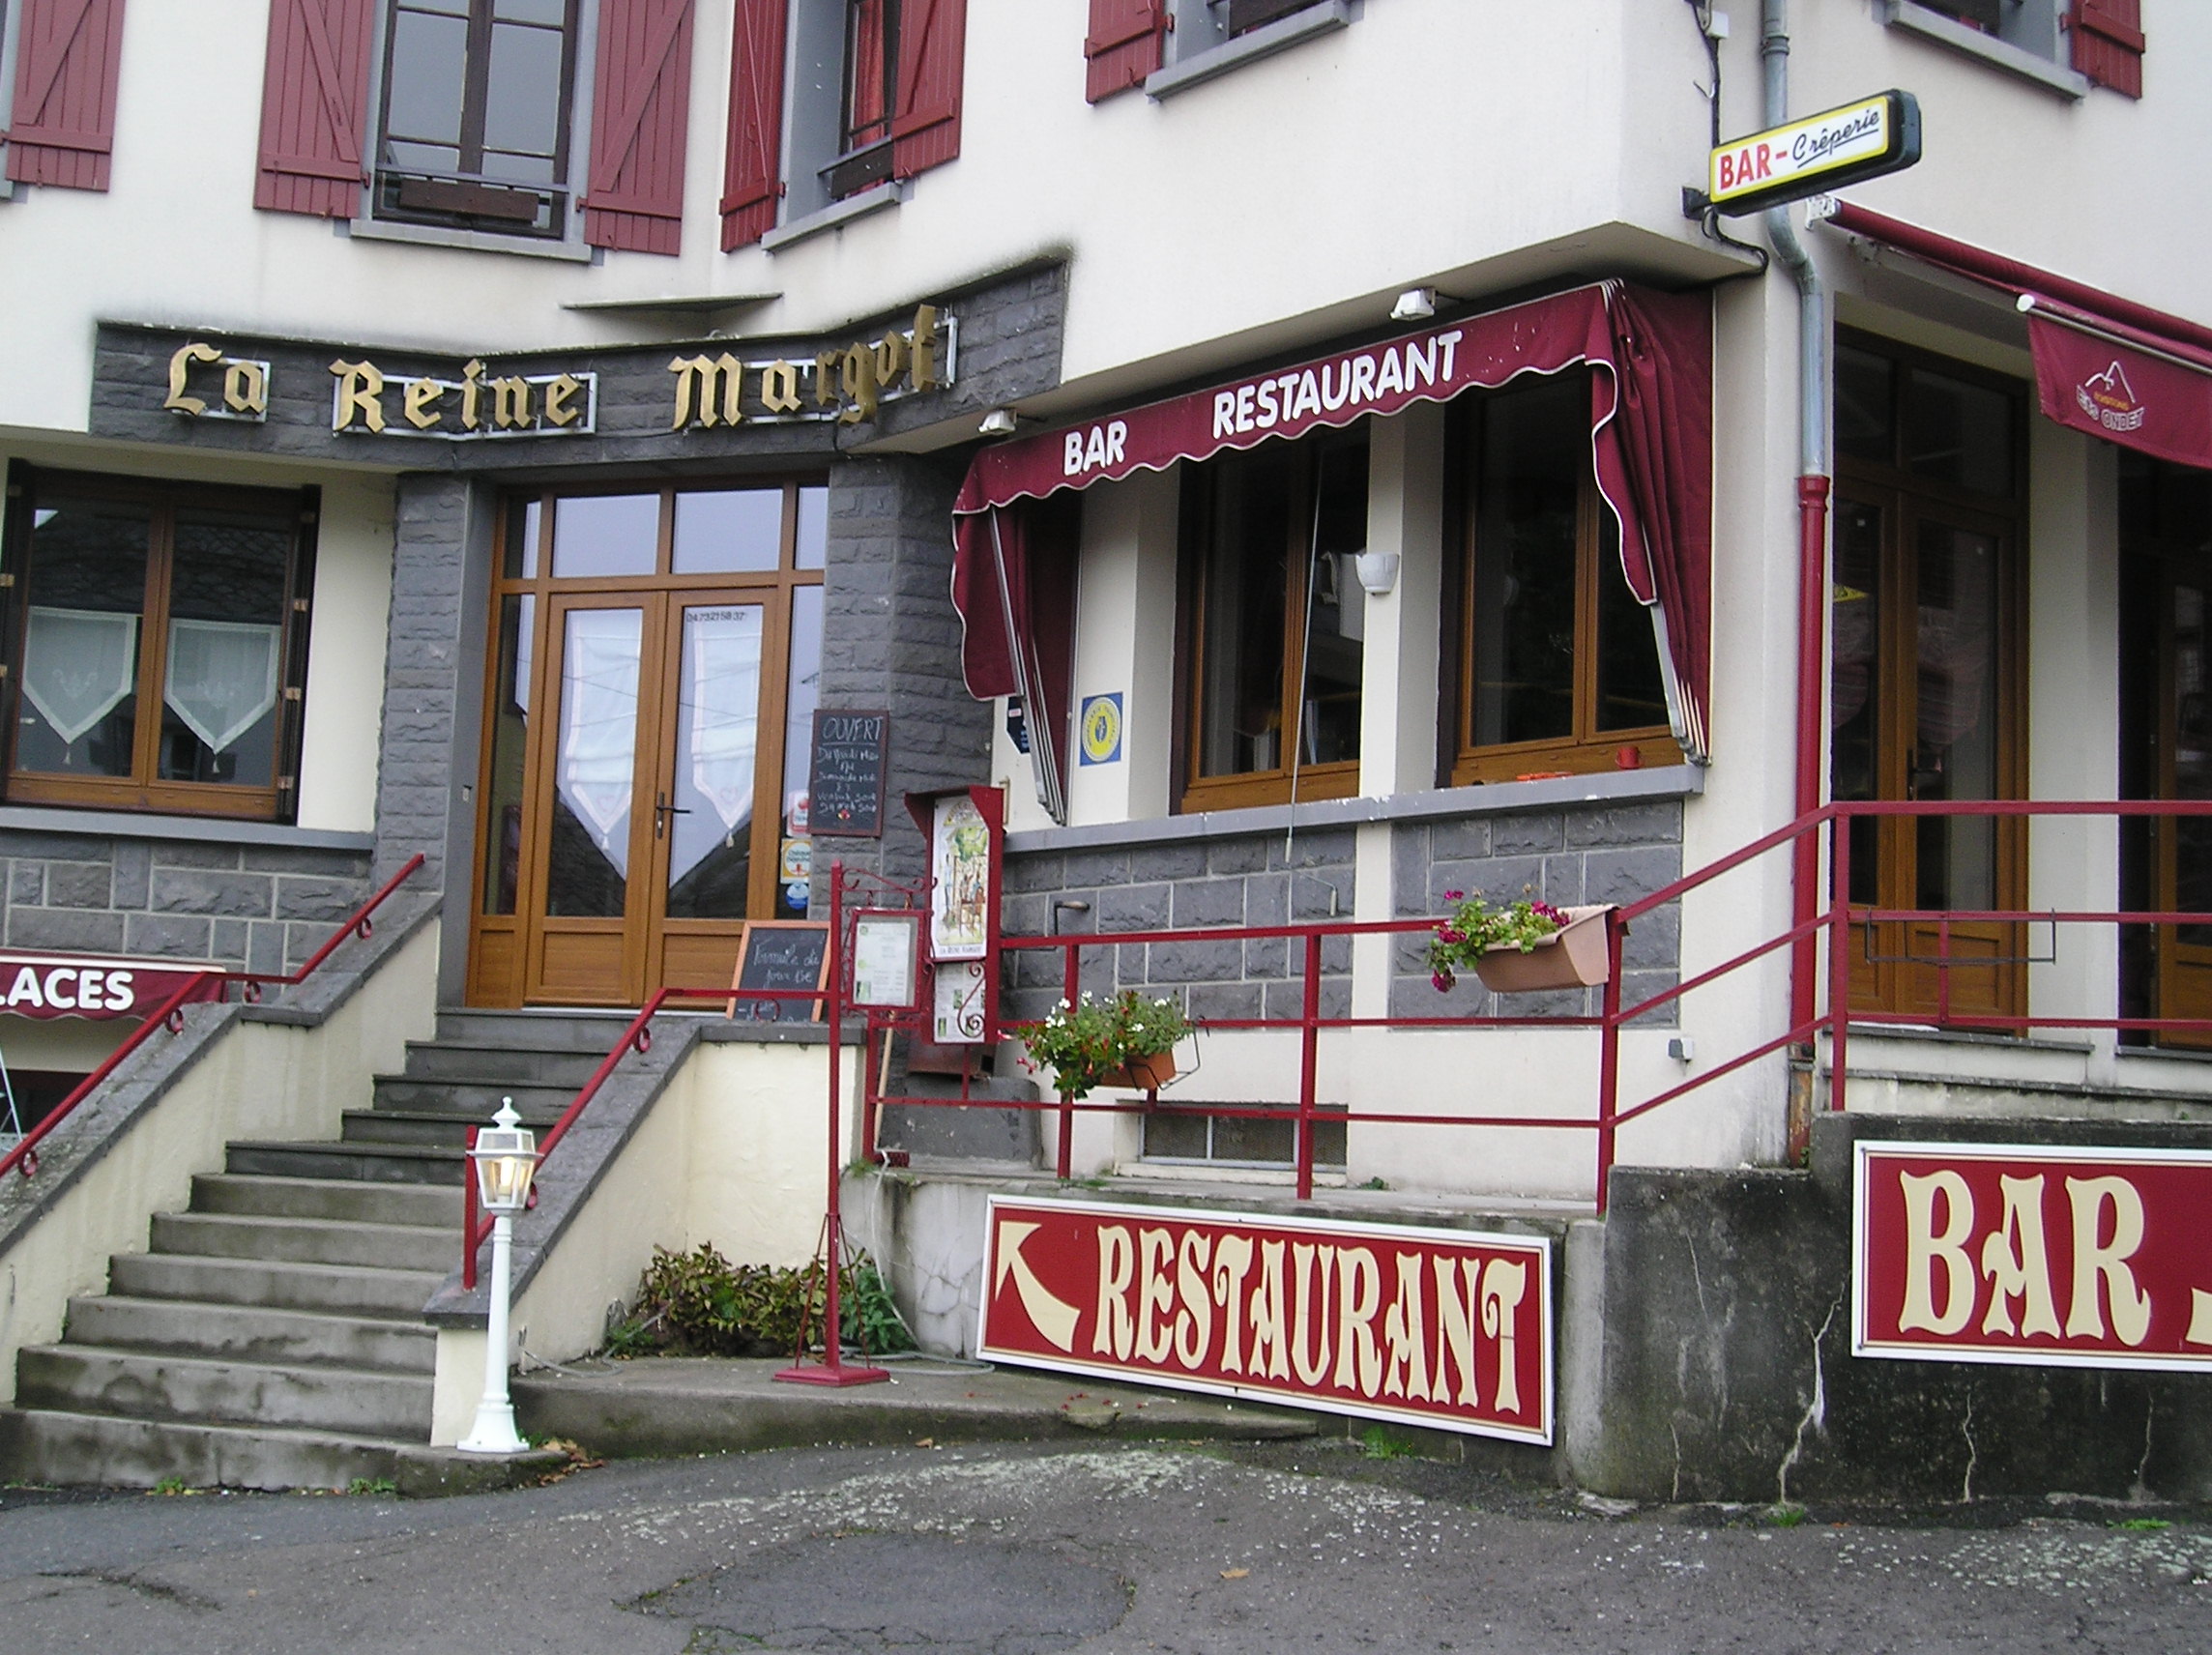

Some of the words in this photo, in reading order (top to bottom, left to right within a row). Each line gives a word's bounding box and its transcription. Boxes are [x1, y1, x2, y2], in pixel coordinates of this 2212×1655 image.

[1791, 108, 1880, 160] Crêperie
[162, 342, 268, 416] La
[328, 358, 580, 433] Reine
[667, 304, 937, 430] Margot
[1063, 421, 1127, 477] BAR
[1211, 331, 1463, 439] RESTAURANT
[0, 967, 134, 1011] ACES
[1091, 1225, 1527, 1415] RESTAURANT
[1898, 1169, 2152, 1347] BAR
